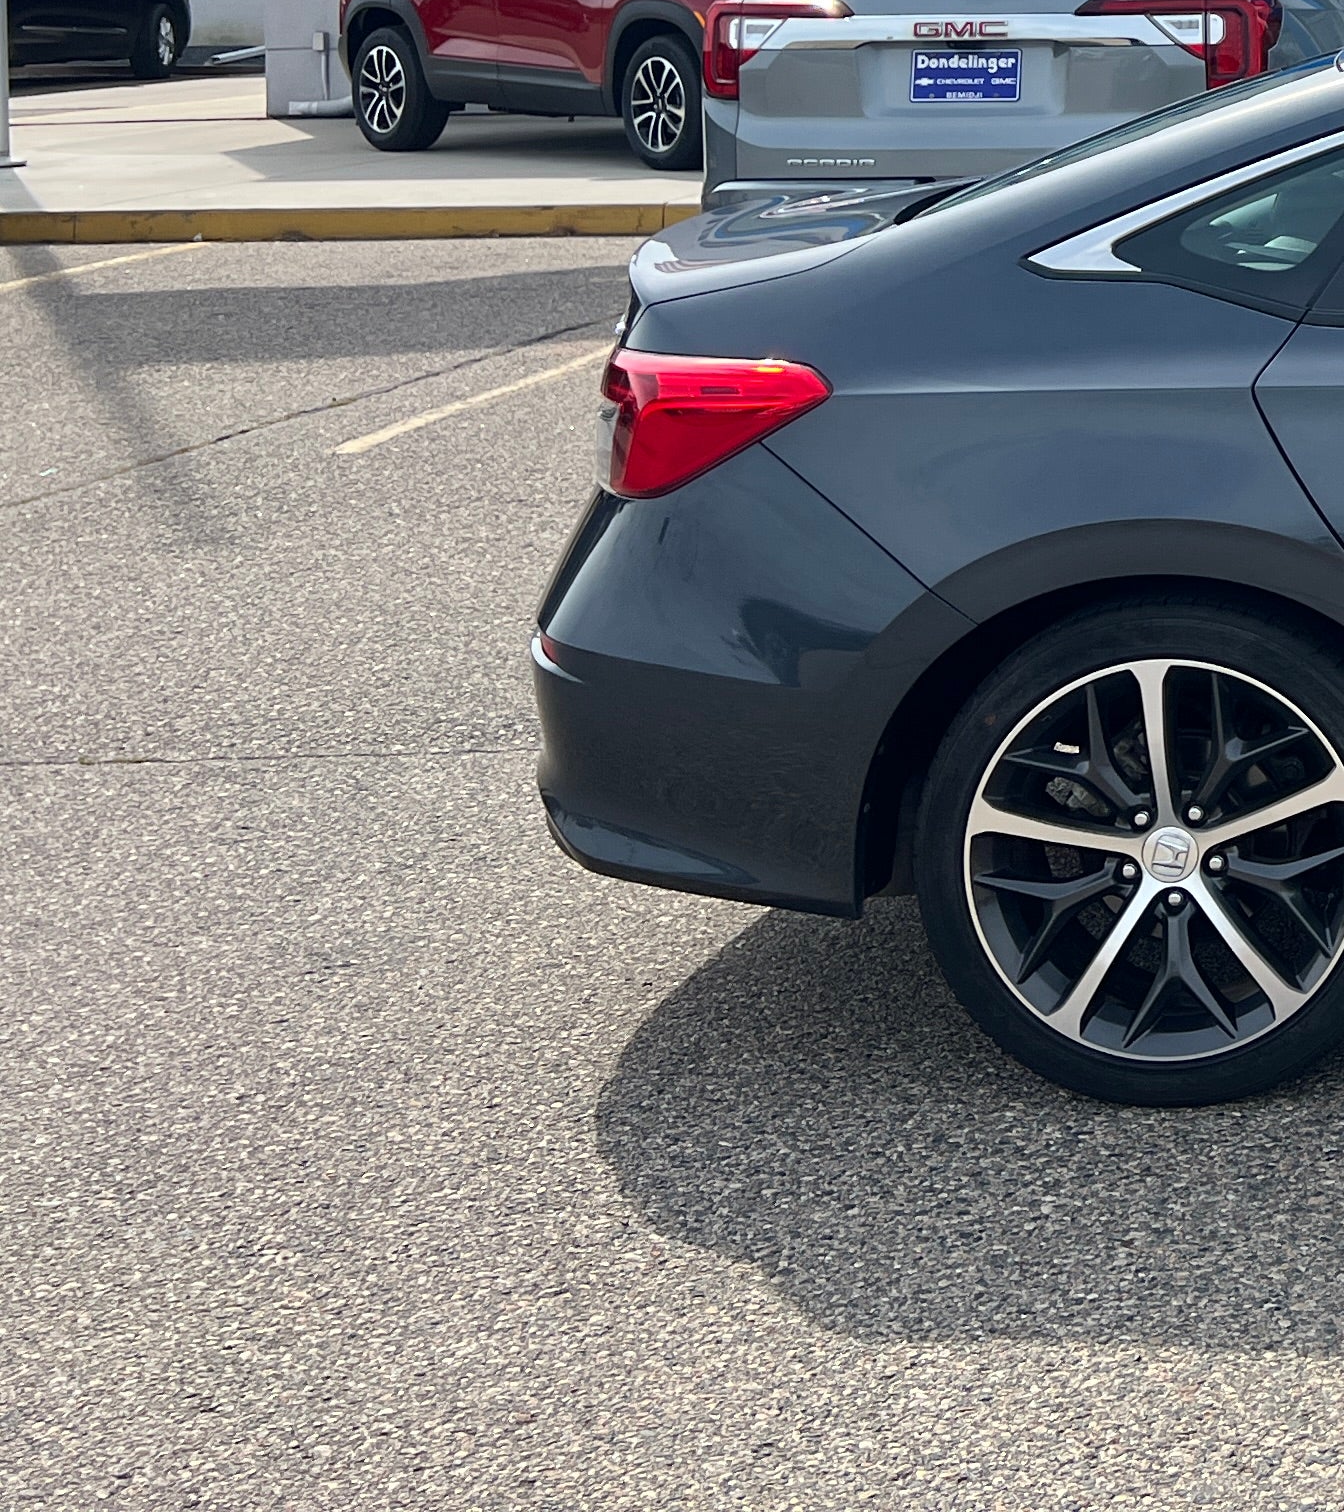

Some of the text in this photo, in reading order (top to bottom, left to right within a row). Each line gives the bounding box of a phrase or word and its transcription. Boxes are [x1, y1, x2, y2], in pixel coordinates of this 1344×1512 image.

[913, 21, 1008, 38] GMC
[916, 54, 1016, 74] Dondelinger
[991, 77, 1017, 85] GMC
[945, 91, 983, 99] BEMIDJI
